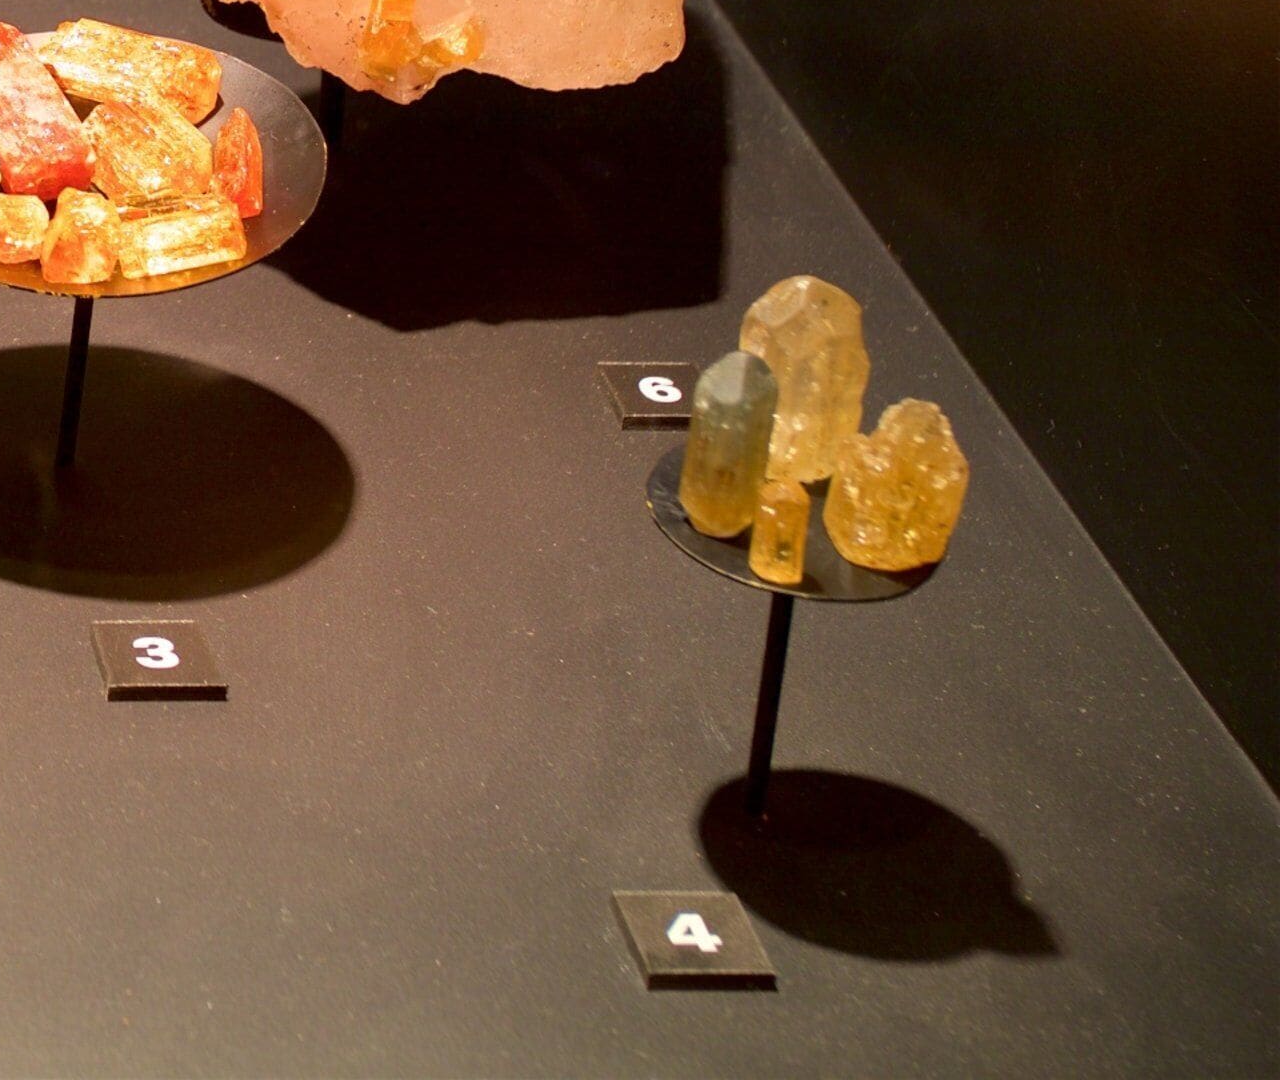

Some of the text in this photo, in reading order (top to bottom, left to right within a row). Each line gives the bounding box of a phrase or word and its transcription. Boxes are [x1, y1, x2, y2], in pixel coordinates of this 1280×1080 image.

[637, 375, 683, 404] 6
[131, 636, 181, 670] 3
[665, 911, 725, 954] 4
